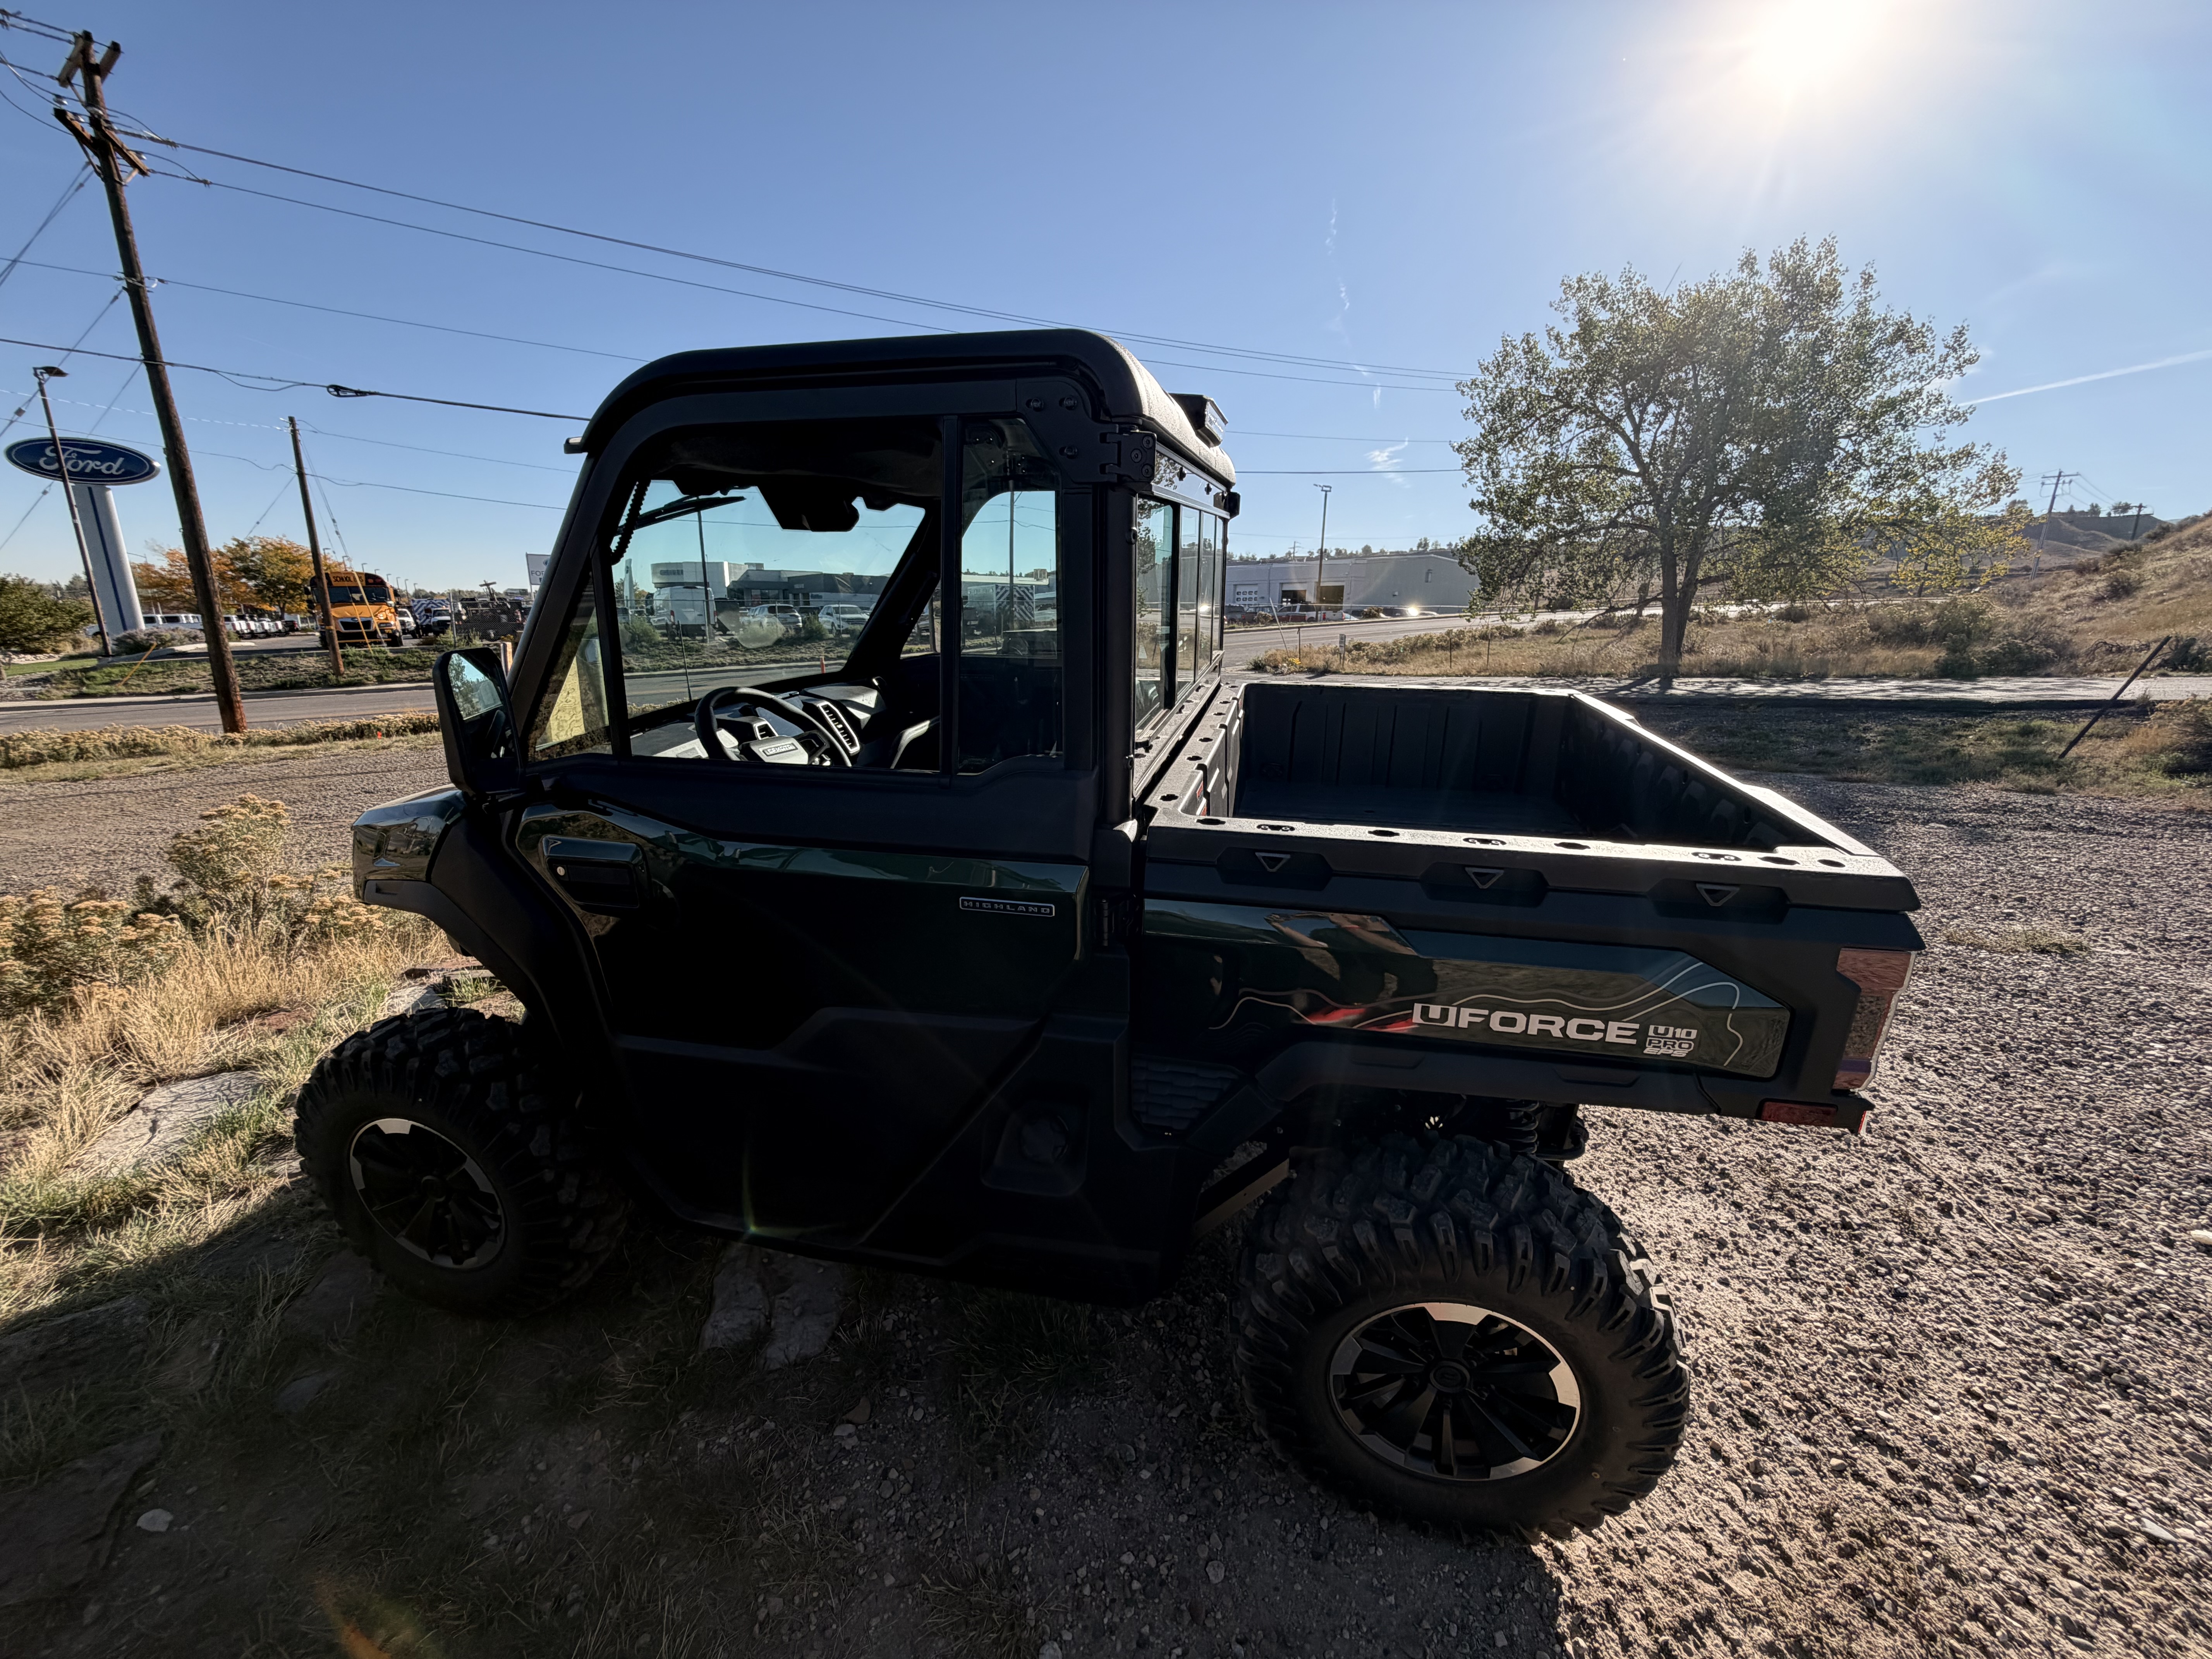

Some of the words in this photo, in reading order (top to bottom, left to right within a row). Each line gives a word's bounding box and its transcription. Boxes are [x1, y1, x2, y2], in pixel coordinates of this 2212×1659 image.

[39, 446, 125, 475] Ford
[963, 901, 1050, 914] HIGHLAND
[1412, 1003, 1640, 1044] UFORCE
[1648, 1025, 1698, 1039] U10
[1646, 1037, 1694, 1051] PRO
[1643, 1048, 1689, 1057] EPS
